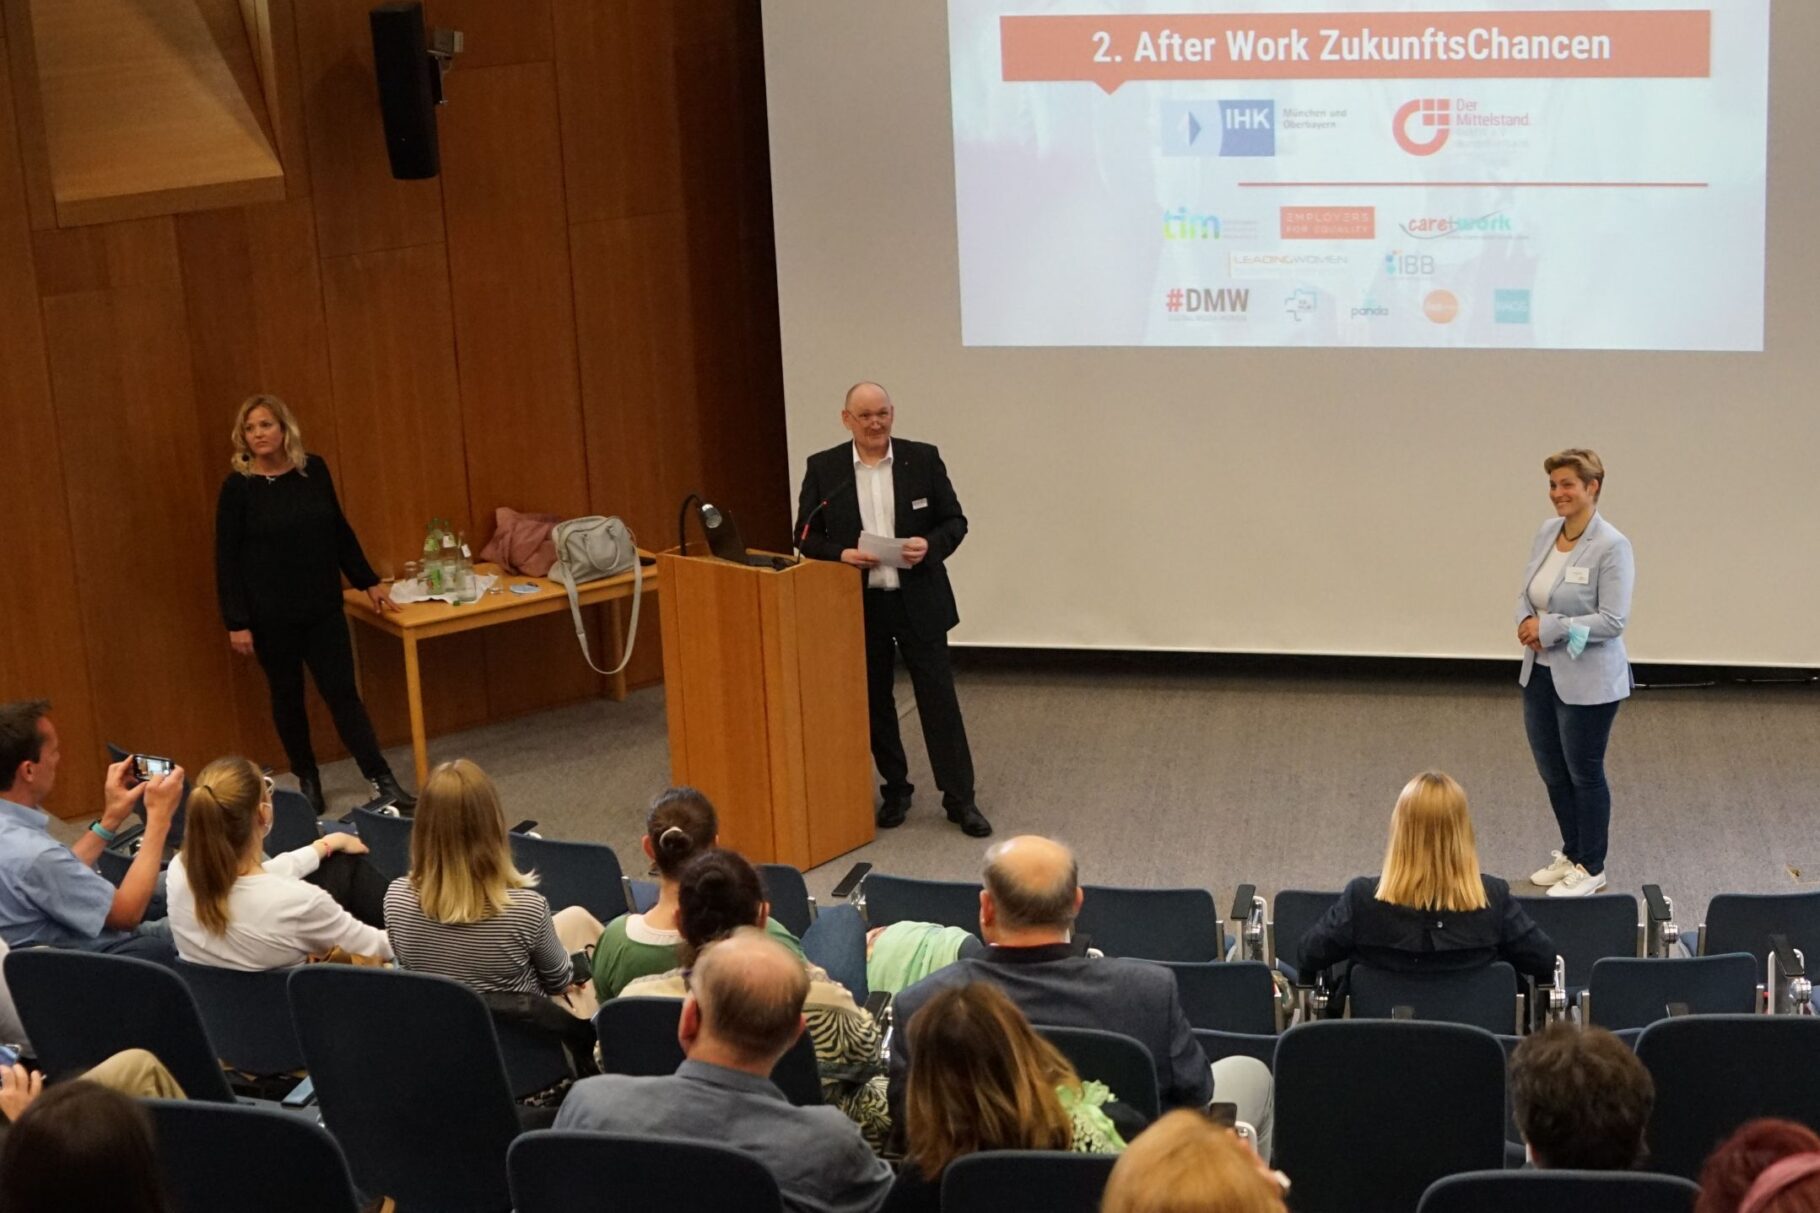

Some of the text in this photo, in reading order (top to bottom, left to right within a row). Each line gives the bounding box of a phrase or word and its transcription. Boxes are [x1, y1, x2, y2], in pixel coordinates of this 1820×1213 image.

[1092, 27, 1611, 62] 2. After Work ZukunftsChancen
[1329, 108, 1348, 118] und
[1456, 98, 1478, 112] Der
[1225, 108, 1270, 129] IHK
[1162, 205, 1221, 241] tim
[1286, 211, 1370, 223] EMPLOYERS
[1166, 288, 1250, 313] #DMW
